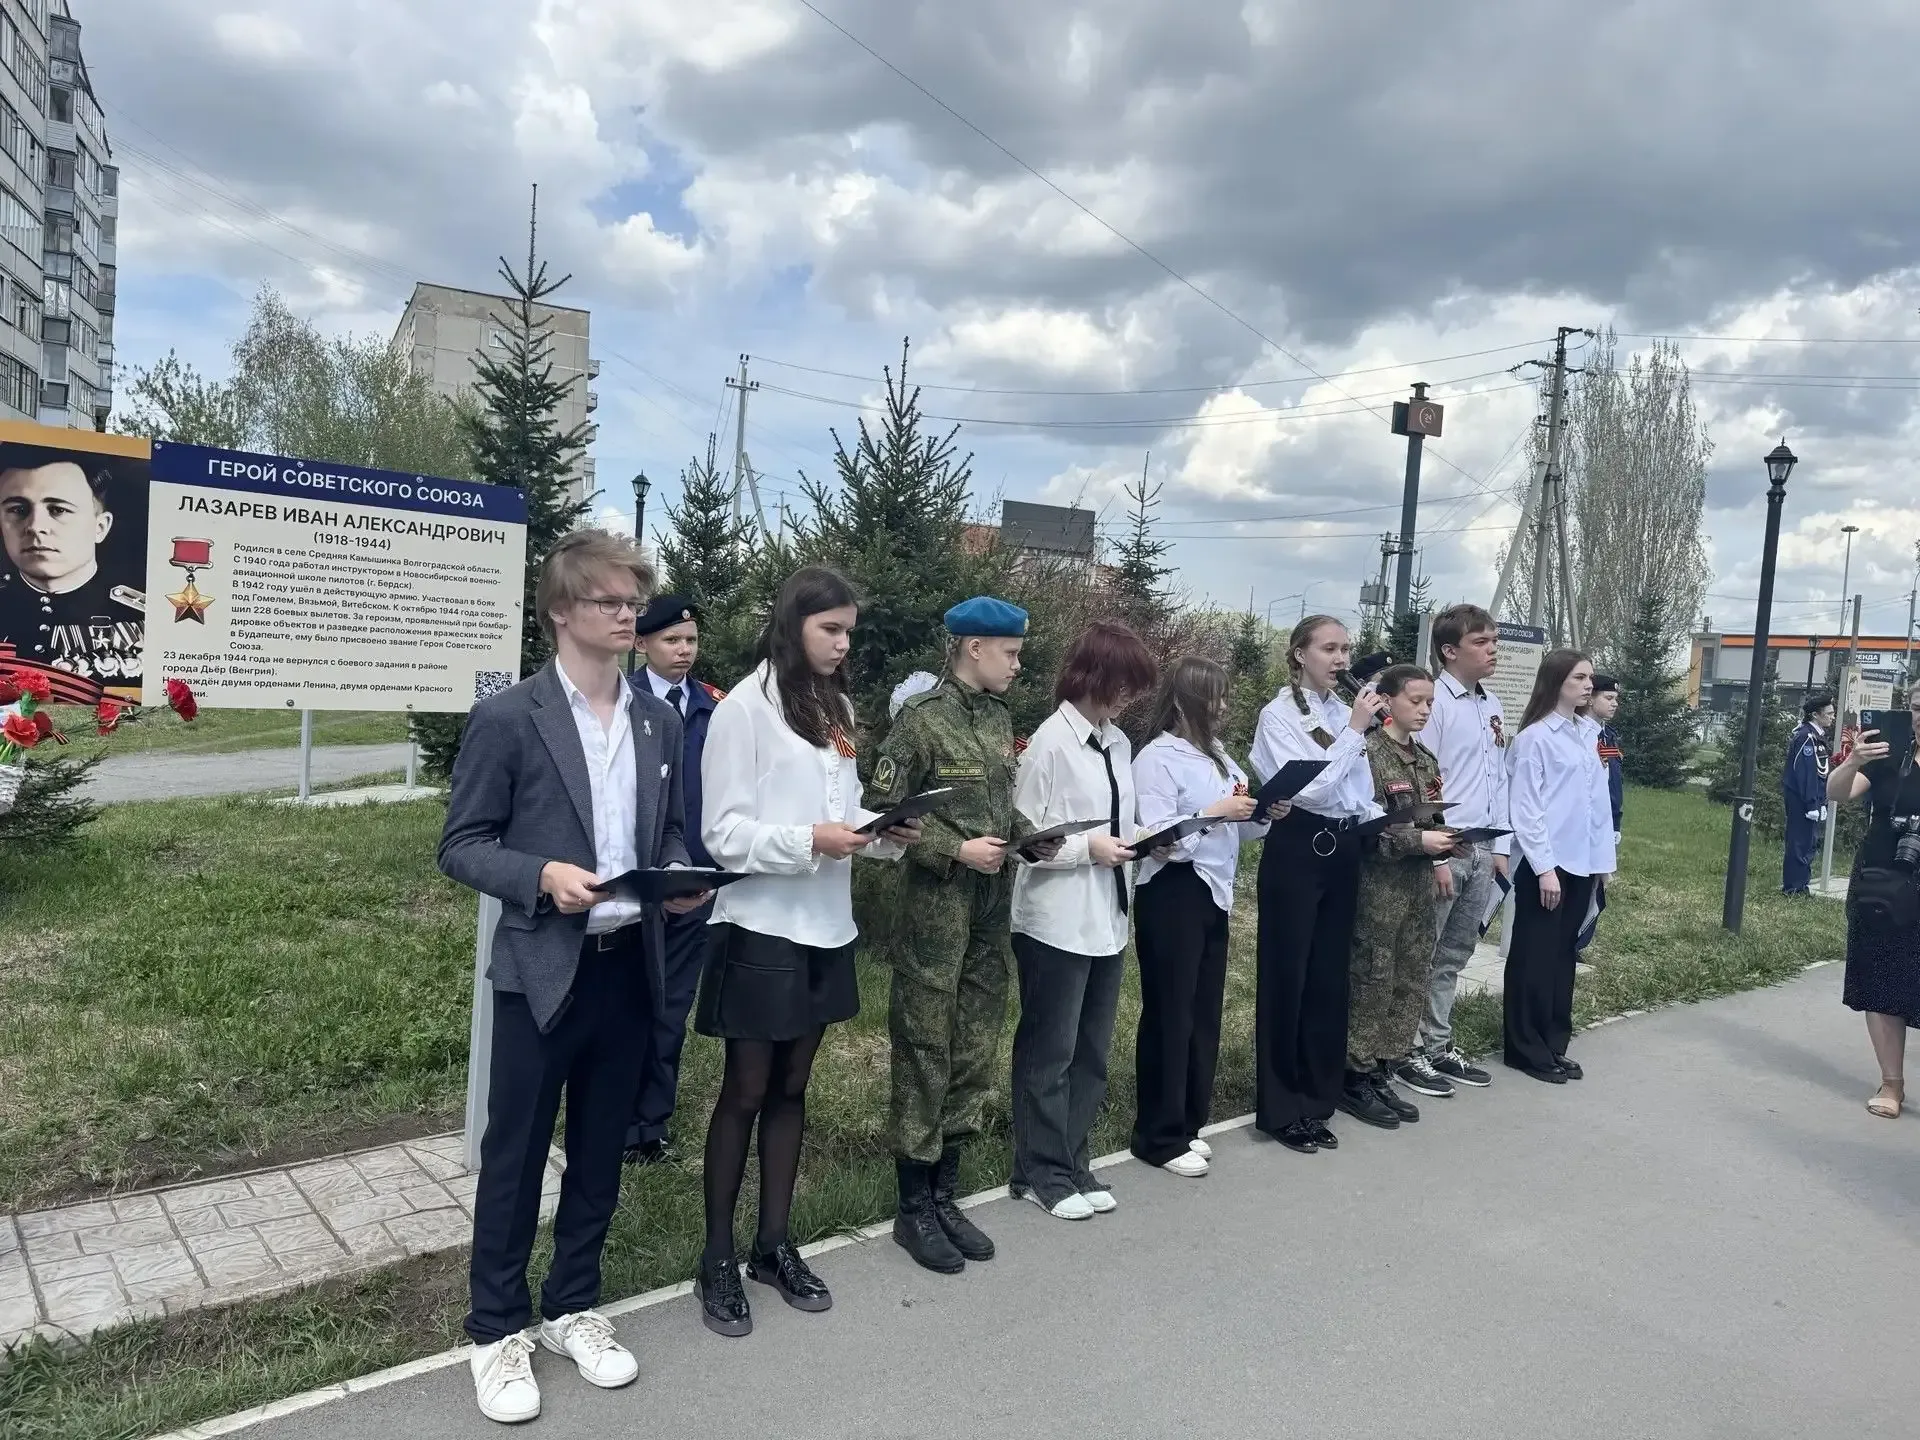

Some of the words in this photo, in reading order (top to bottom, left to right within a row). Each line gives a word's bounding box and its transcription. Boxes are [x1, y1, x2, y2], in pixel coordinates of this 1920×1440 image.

[209, 459, 276, 482] ГЕРОЙ
[283, 469, 412, 498] СОВЕТСКОГО
[417, 486, 483, 508] СОЮЗА
[178, 495, 277, 520] ЛАЗАРЕВ
[283, 507, 338, 527] ИВАН
[343, 514, 505, 545] АЛЕКСАНДРОВИЧ
[314, 531, 391, 551] (1918-1944)
[234, 542, 275, 554] Родился
[284, 549, 306, 557] селе
[308, 549, 348, 560] Средняя
[349, 553, 401, 565] Камышинка
[403, 558, 465, 571] Волгоградской
[466, 565, 501, 574] области.
[233, 555, 241, 563] С
[243, 556, 266, 565] 1940
[268, 559, 290, 568] года
[292, 561, 330, 571] работал
[331, 565, 394, 576] инструктором
[403, 570, 468, 582] Новосибирской
[469, 577, 501, 585] военно-
[233, 569, 295, 580] авиационной
[297, 574, 327, 582] школе
[328, 577, 364, 585] пилотов
[232, 579, 239, 588] В
[241, 580, 264, 590] 1942
[266, 584, 288, 593] году
[323, 588, 387, 600] действующую
[388, 593, 420, 601] армию.
[422, 594, 469, 605] Участвовал
[476, 598, 495, 607] боях
[231, 593, 250, 602] под
[252, 593, 296, 605] Гомелем,
[298, 597, 340, 608] Вязьмой,
[341, 599, 391, 610] Витебском.
[393, 603, 399, 611] К
[401, 605, 437, 614] октябрю
[439, 607, 459, 615] 1944
[480, 611, 507, 619] совер-
[230, 618, 271, 627] дировке
[273, 620, 317, 629] объектов
[326, 624, 368, 632] разведке
[369, 626, 432, 635] расположения
[433, 630, 478, 638] вражеских
[479, 632, 503, 640] войск
[253, 606, 272, 615] 228
[273, 607, 308, 617] боевых
[310, 611, 351, 619] вылетов.
[353, 612, 363, 620] За
[365, 615, 403, 624] героизм,
[405, 617, 461, 626] проявленный
[478, 620, 511, 631] бомбар-
[229, 641, 264, 651] Союза.
[238, 629, 293, 641] Будапеште,
[295, 634, 313, 642] ему
[314, 634, 338, 642] было
[340, 636, 387, 645] присвоено
[389, 639, 418, 647] звание
[419, 639, 443, 648] Героя
[445, 641, 492, 650] Советского
[163, 651, 176, 659] 23
[178, 652, 221, 662] декабря
[223, 653, 246, 662] 1944
[249, 656, 271, 664] года
[286, 657, 328, 666] вернулся
[337, 658, 373, 667] боевого
[163, 665, 198, 673] города
[200, 665, 226, 675] Дьёр
[229, 665, 277, 676] (Венгрия).
[162, 676, 219, 686] Нраждён
[221, 679, 252, 688] двумя
[254, 680, 301, 688] орденами
[302, 680, 338, 690] Ленина,
[339, 683, 368, 691] двумя
[369, 684, 412, 692] орденами
[414, 684, 453, 693] Красного
